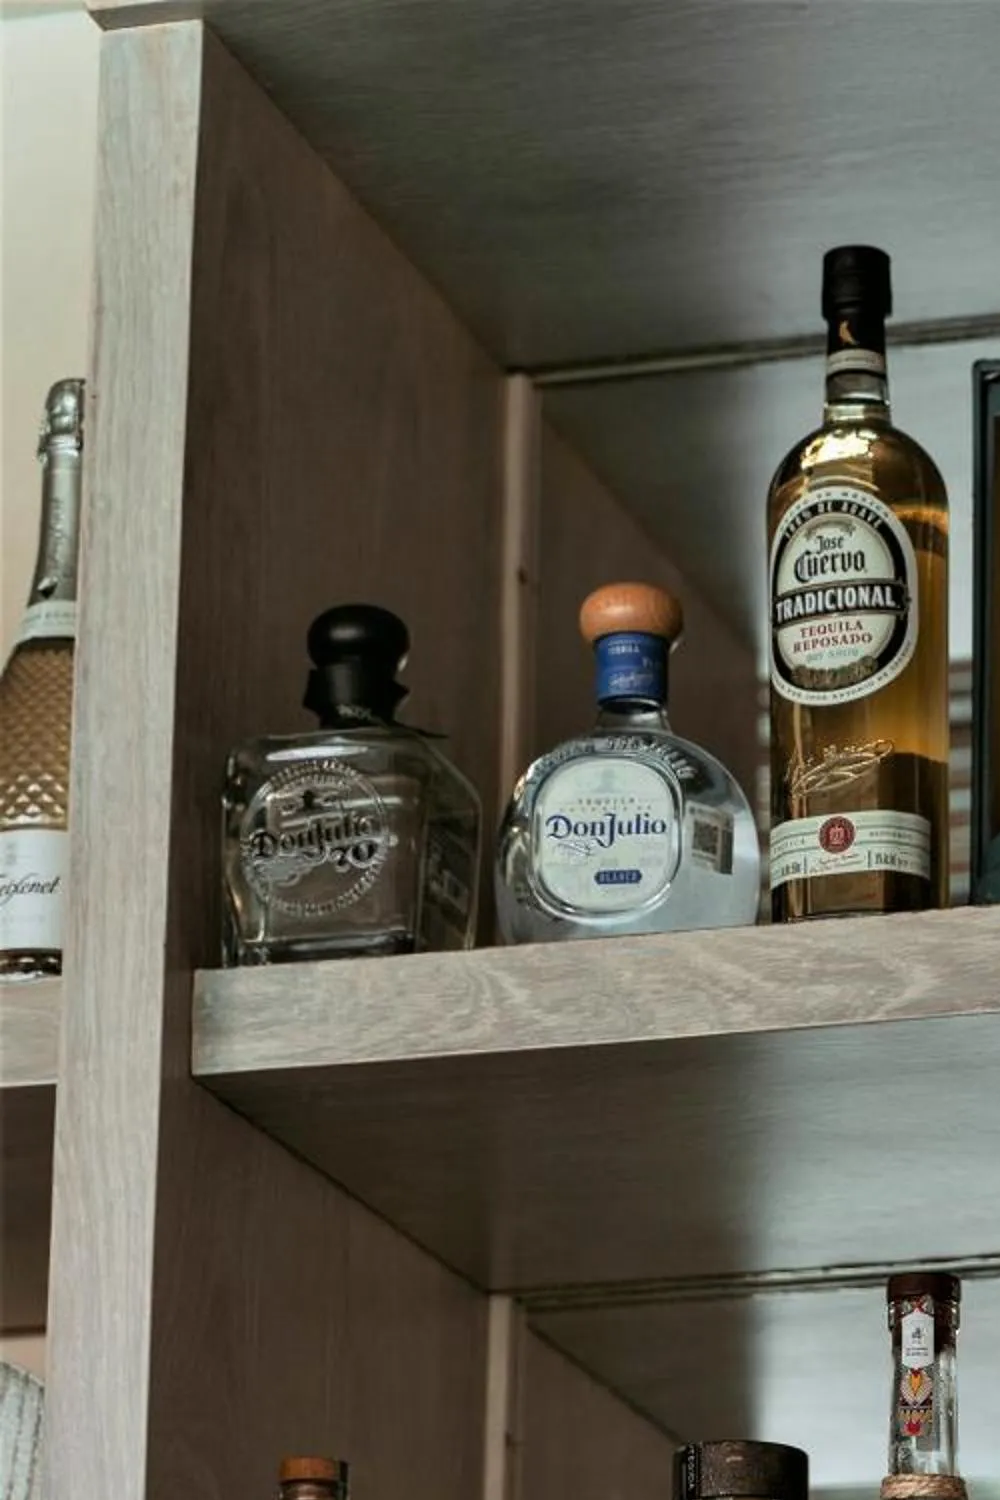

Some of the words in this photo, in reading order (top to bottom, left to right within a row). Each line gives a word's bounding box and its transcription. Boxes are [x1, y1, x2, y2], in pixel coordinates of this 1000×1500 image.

[794, 549, 867, 584] Cuervo
[776, 584, 897, 624] TRADICIONAL
[793, 632, 873, 654] REPOSADO
[800, 619, 863, 639] TEQUILA
